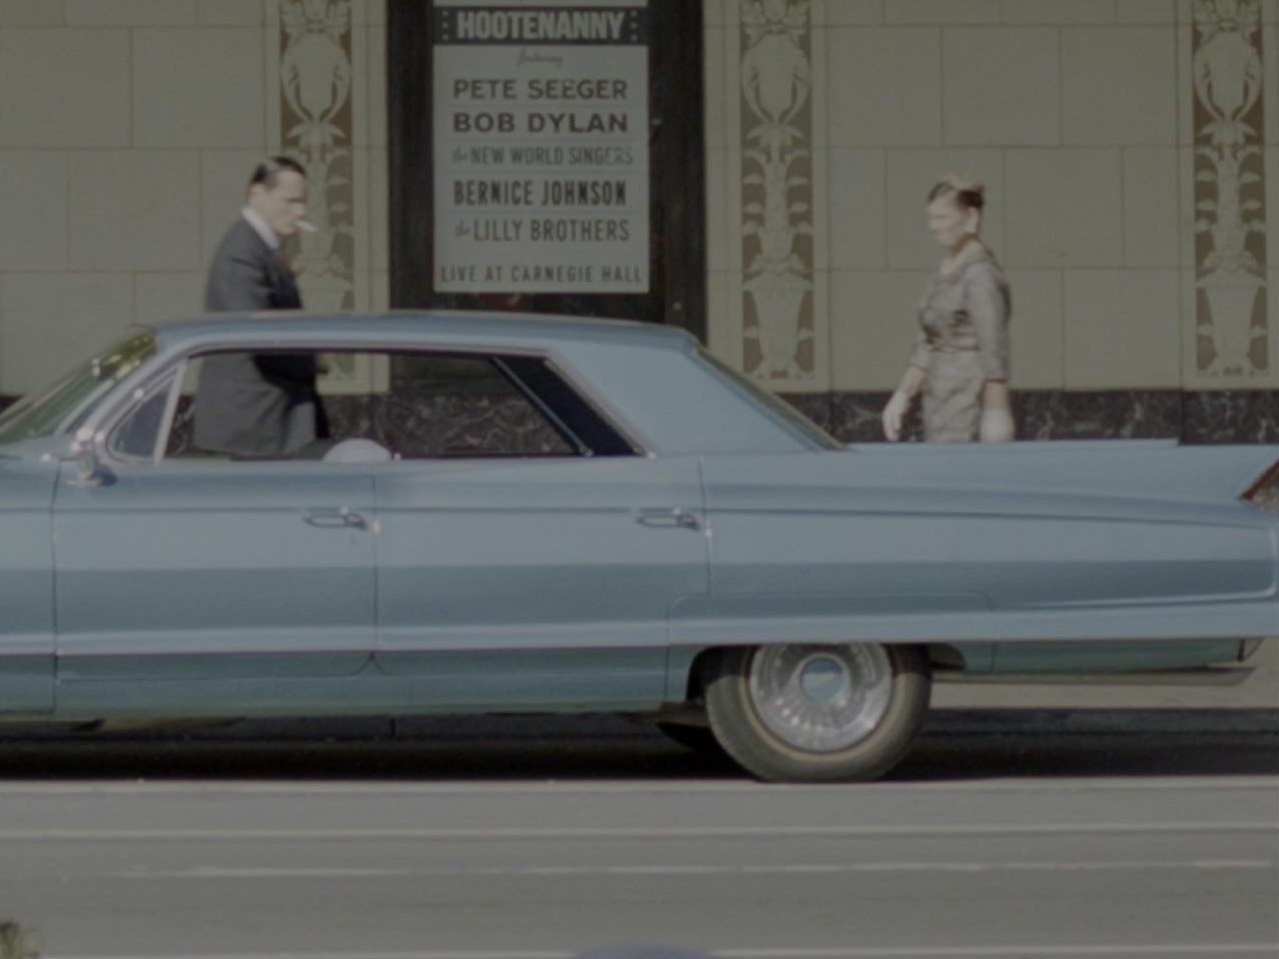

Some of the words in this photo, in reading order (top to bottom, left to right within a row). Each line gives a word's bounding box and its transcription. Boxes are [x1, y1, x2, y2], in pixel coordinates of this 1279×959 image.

[456, 11, 625, 40] HOOTENANNY
[454, 79, 517, 99] PETE
[528, 79, 628, 99] SEEGER
[454, 113, 515, 133] BOB
[528, 113, 628, 133] DYLAN
[470, 146, 505, 164] NEW
[510, 146, 563, 164] WORLD
[568, 146, 633, 165] SINGERS
[454, 180, 533, 205] BERNICE
[541, 180, 626, 205] JOHNSON
[474, 219, 523, 241] LILLY
[530, 219, 630, 241] BROTHERS
[441, 265, 476, 282] LIVE
[485, 265, 503, 282] AT
[511, 265, 593, 283] CARNEGIE
[601, 265, 641, 283] HALL
